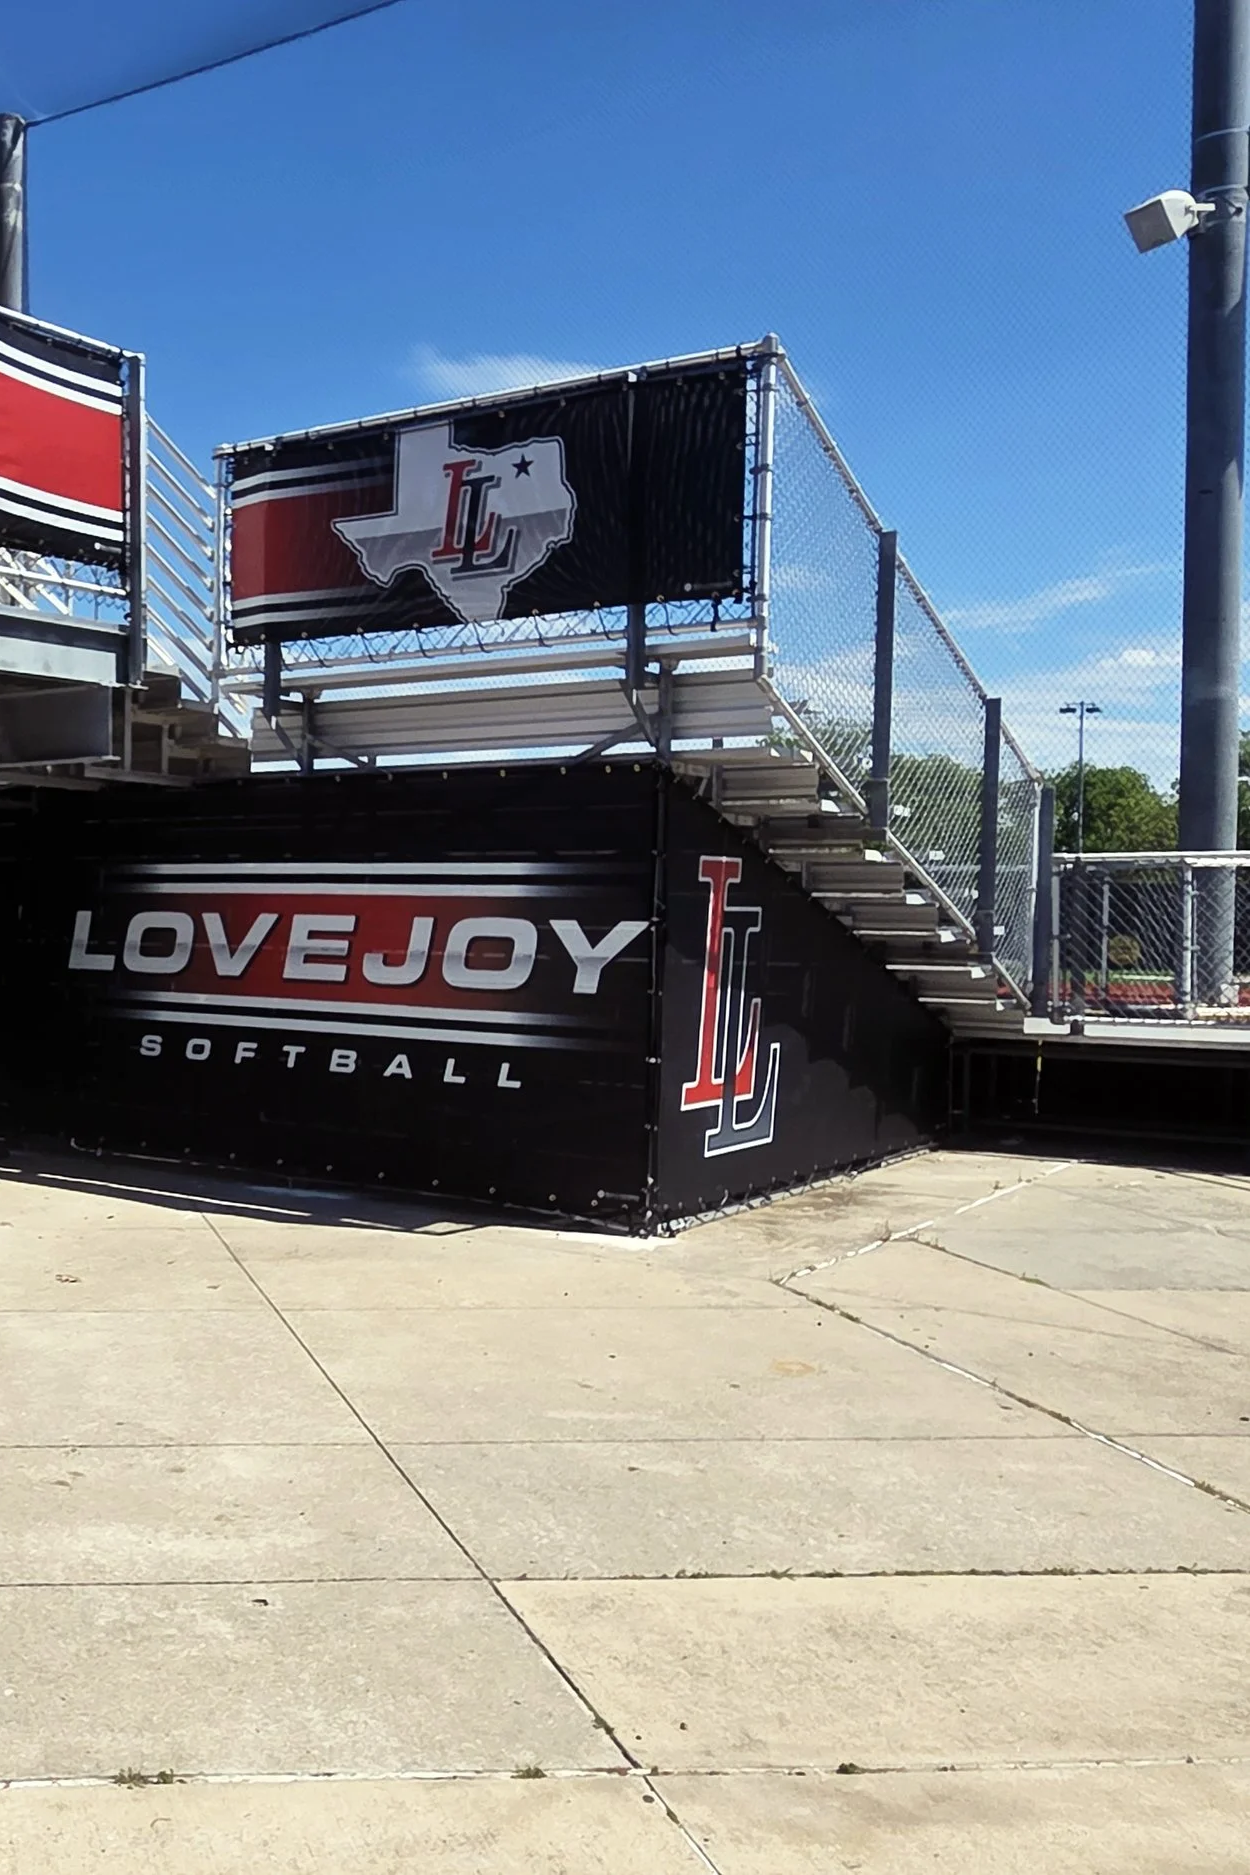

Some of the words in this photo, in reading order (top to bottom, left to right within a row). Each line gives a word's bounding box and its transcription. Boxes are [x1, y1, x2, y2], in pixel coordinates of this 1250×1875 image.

[431, 458, 519, 580] LL
[68, 909, 651, 995] LOVEJOY
[680, 854, 780, 1158] LL
[138, 1034, 522, 1090] SOFTBALL
